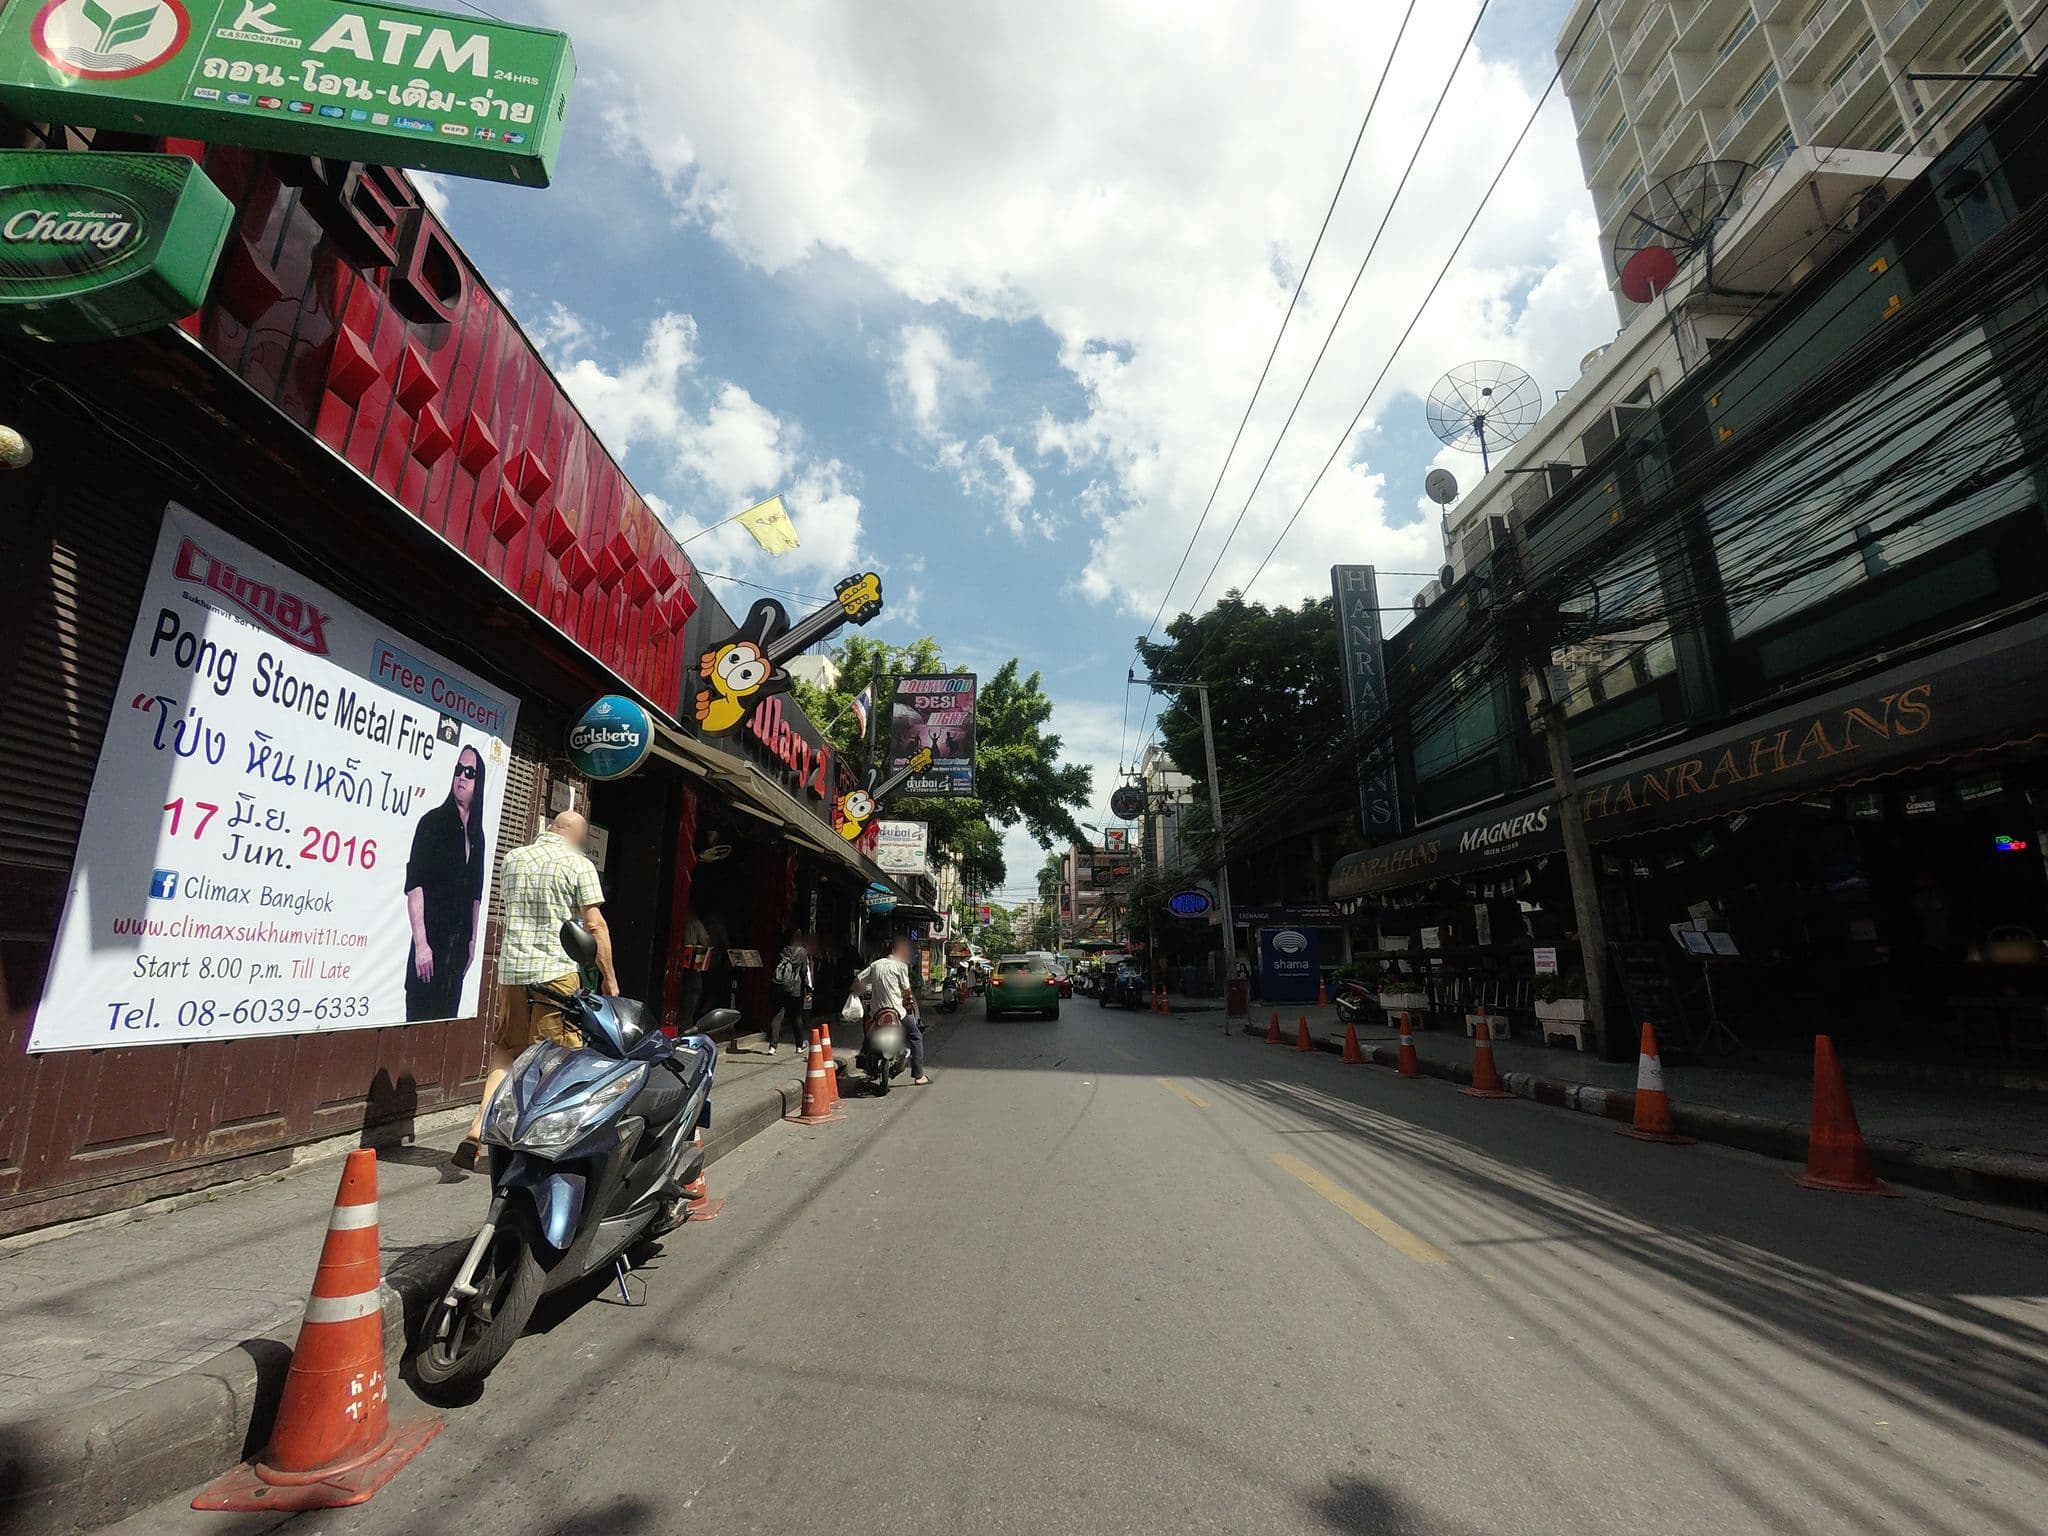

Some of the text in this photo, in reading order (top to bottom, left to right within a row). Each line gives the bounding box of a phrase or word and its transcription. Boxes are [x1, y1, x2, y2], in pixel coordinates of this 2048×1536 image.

[219, 29, 299, 47] KASIKORNTHAI
[308, 13, 539, 85] ATM 24HRS
[3, 209, 133, 249] Chang
[182, 591, 233, 621] Sukhumvit
[234, 615, 250, 627] Soi
[150, 607, 435, 760] Pong Stone Metal Fire
[379, 650, 425, 694] Free
[431, 677, 499, 731] Concert
[915, 695, 956, 709] DESI
[569, 724, 640, 751] Carlsberg
[1583, 683, 1933, 822] HANRAHANS
[906, 775, 938, 788] dubai
[163, 797, 219, 840] 17
[299, 826, 377, 870] 2016
[1459, 805, 1550, 854] MAGNERS
[223, 833, 292, 870] Jun.
[185, 875, 250, 904] Climax
[260, 885, 334, 915] Bangkok
[113, 914, 368, 947] www.climaxsukhumvit11.com
[133, 954, 351, 984] Start 8.00 p.m. Till Late
[1273, 959, 1310, 970] shama
[108, 996, 370, 1031] Tel. 08-6039-6333
